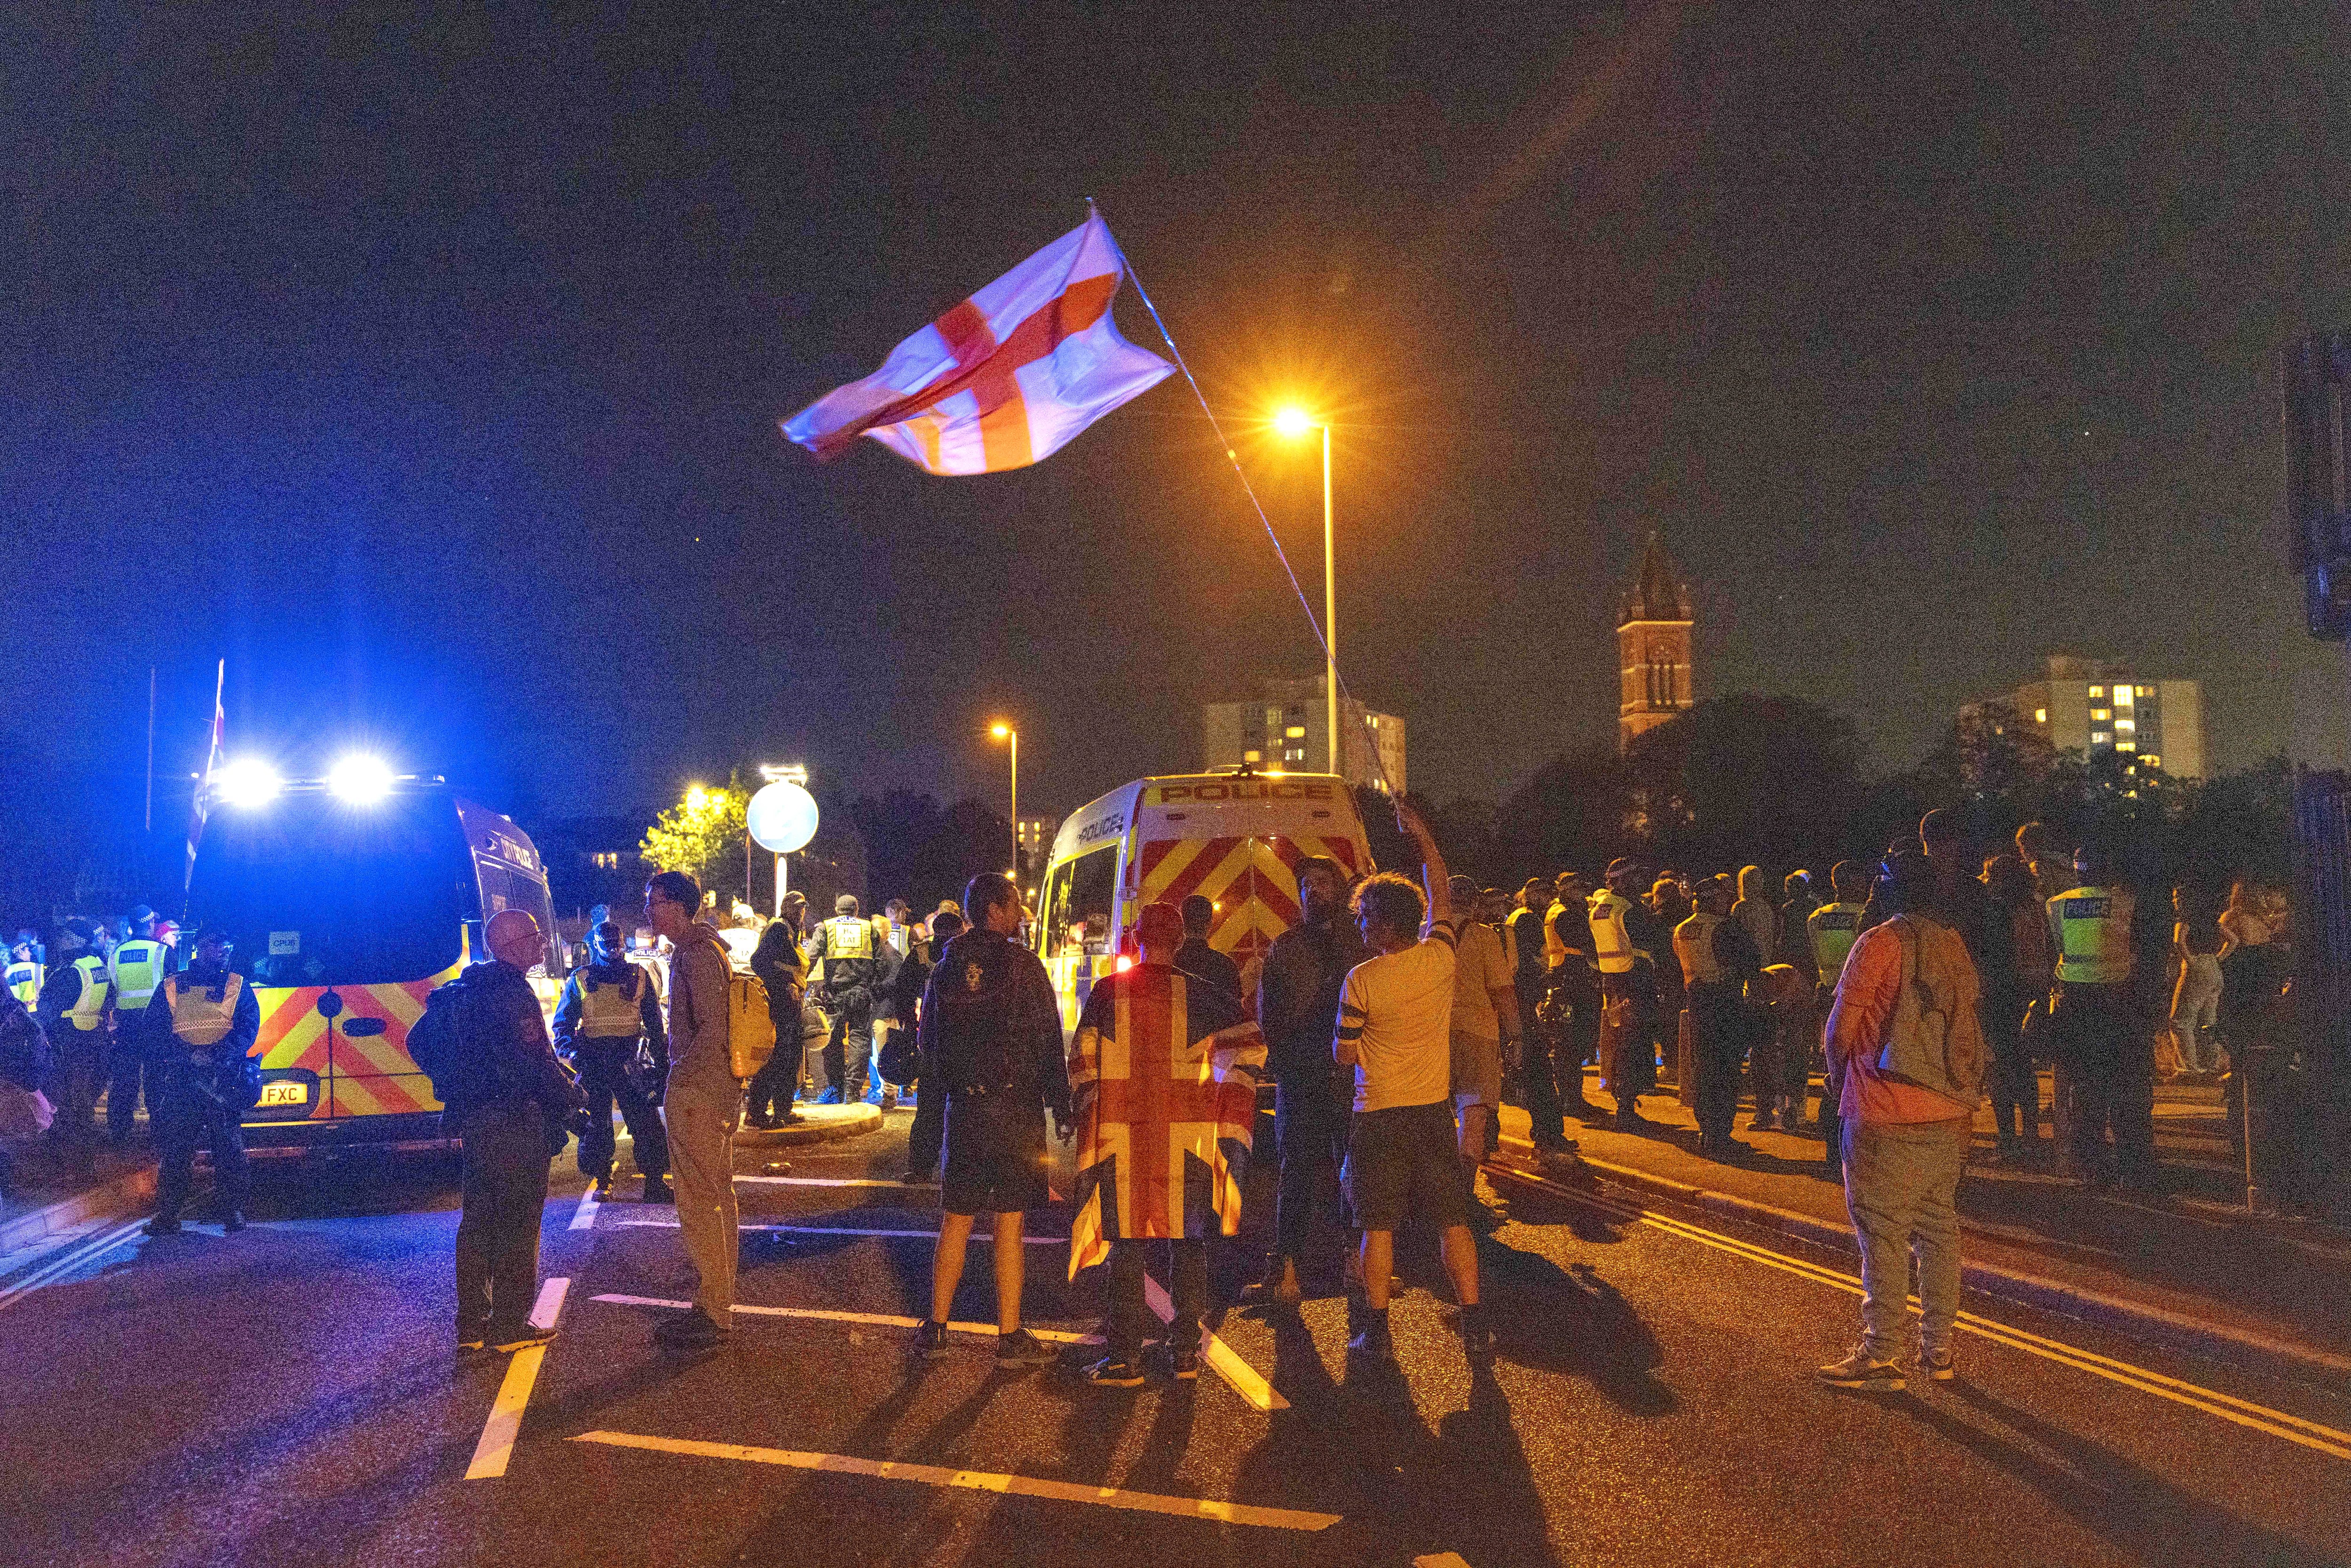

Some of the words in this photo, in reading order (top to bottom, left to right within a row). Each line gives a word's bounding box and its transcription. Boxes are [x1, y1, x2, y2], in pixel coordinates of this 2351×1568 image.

[1158, 784, 1330, 803] POLICE
[1079, 813, 1119, 845] POLICE
[2066, 900, 2110, 916] POLICE
[120, 951, 146, 961] POLICE
[268, 1088, 297, 1102] FXC
